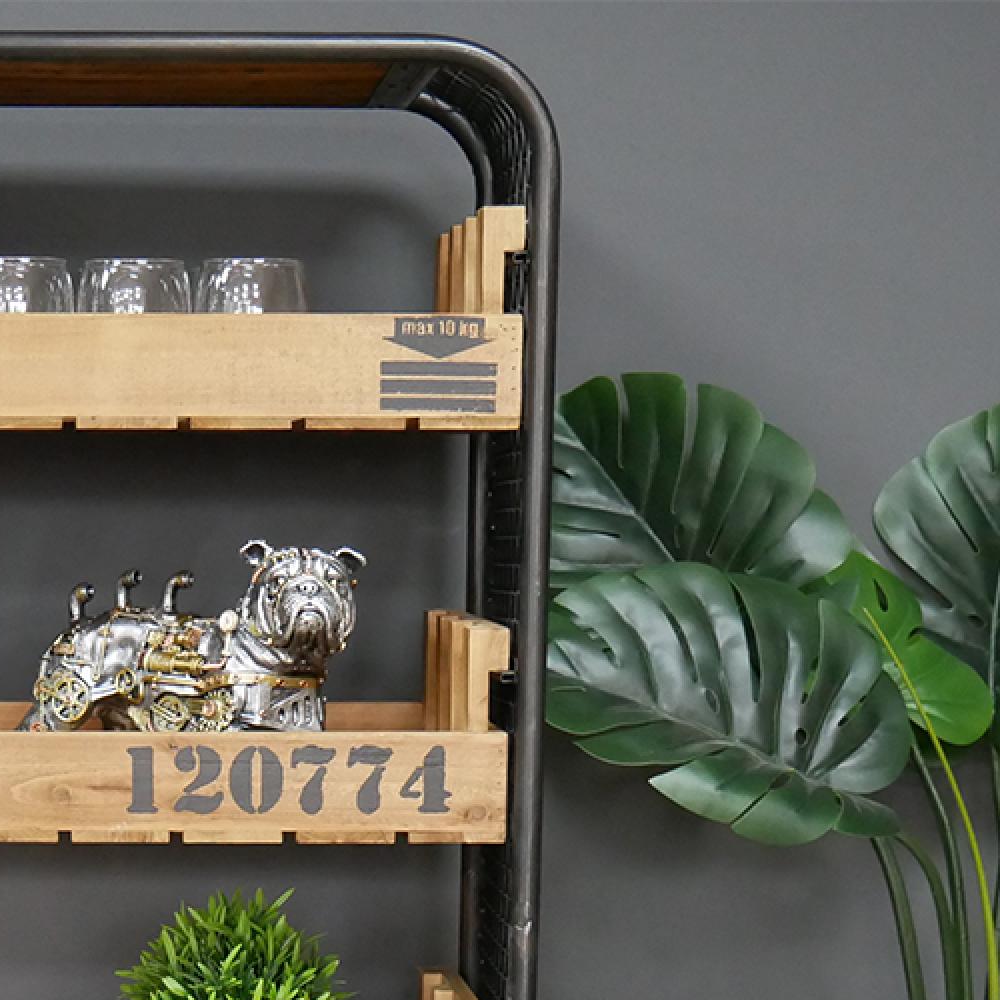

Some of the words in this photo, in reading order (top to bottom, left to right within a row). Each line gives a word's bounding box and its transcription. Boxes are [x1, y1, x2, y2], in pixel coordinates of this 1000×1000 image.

[401, 321, 434, 336] max
[439, 319, 456, 337] 10
[459, 320, 479, 339] kg
[126, 745, 453, 815] 120774
